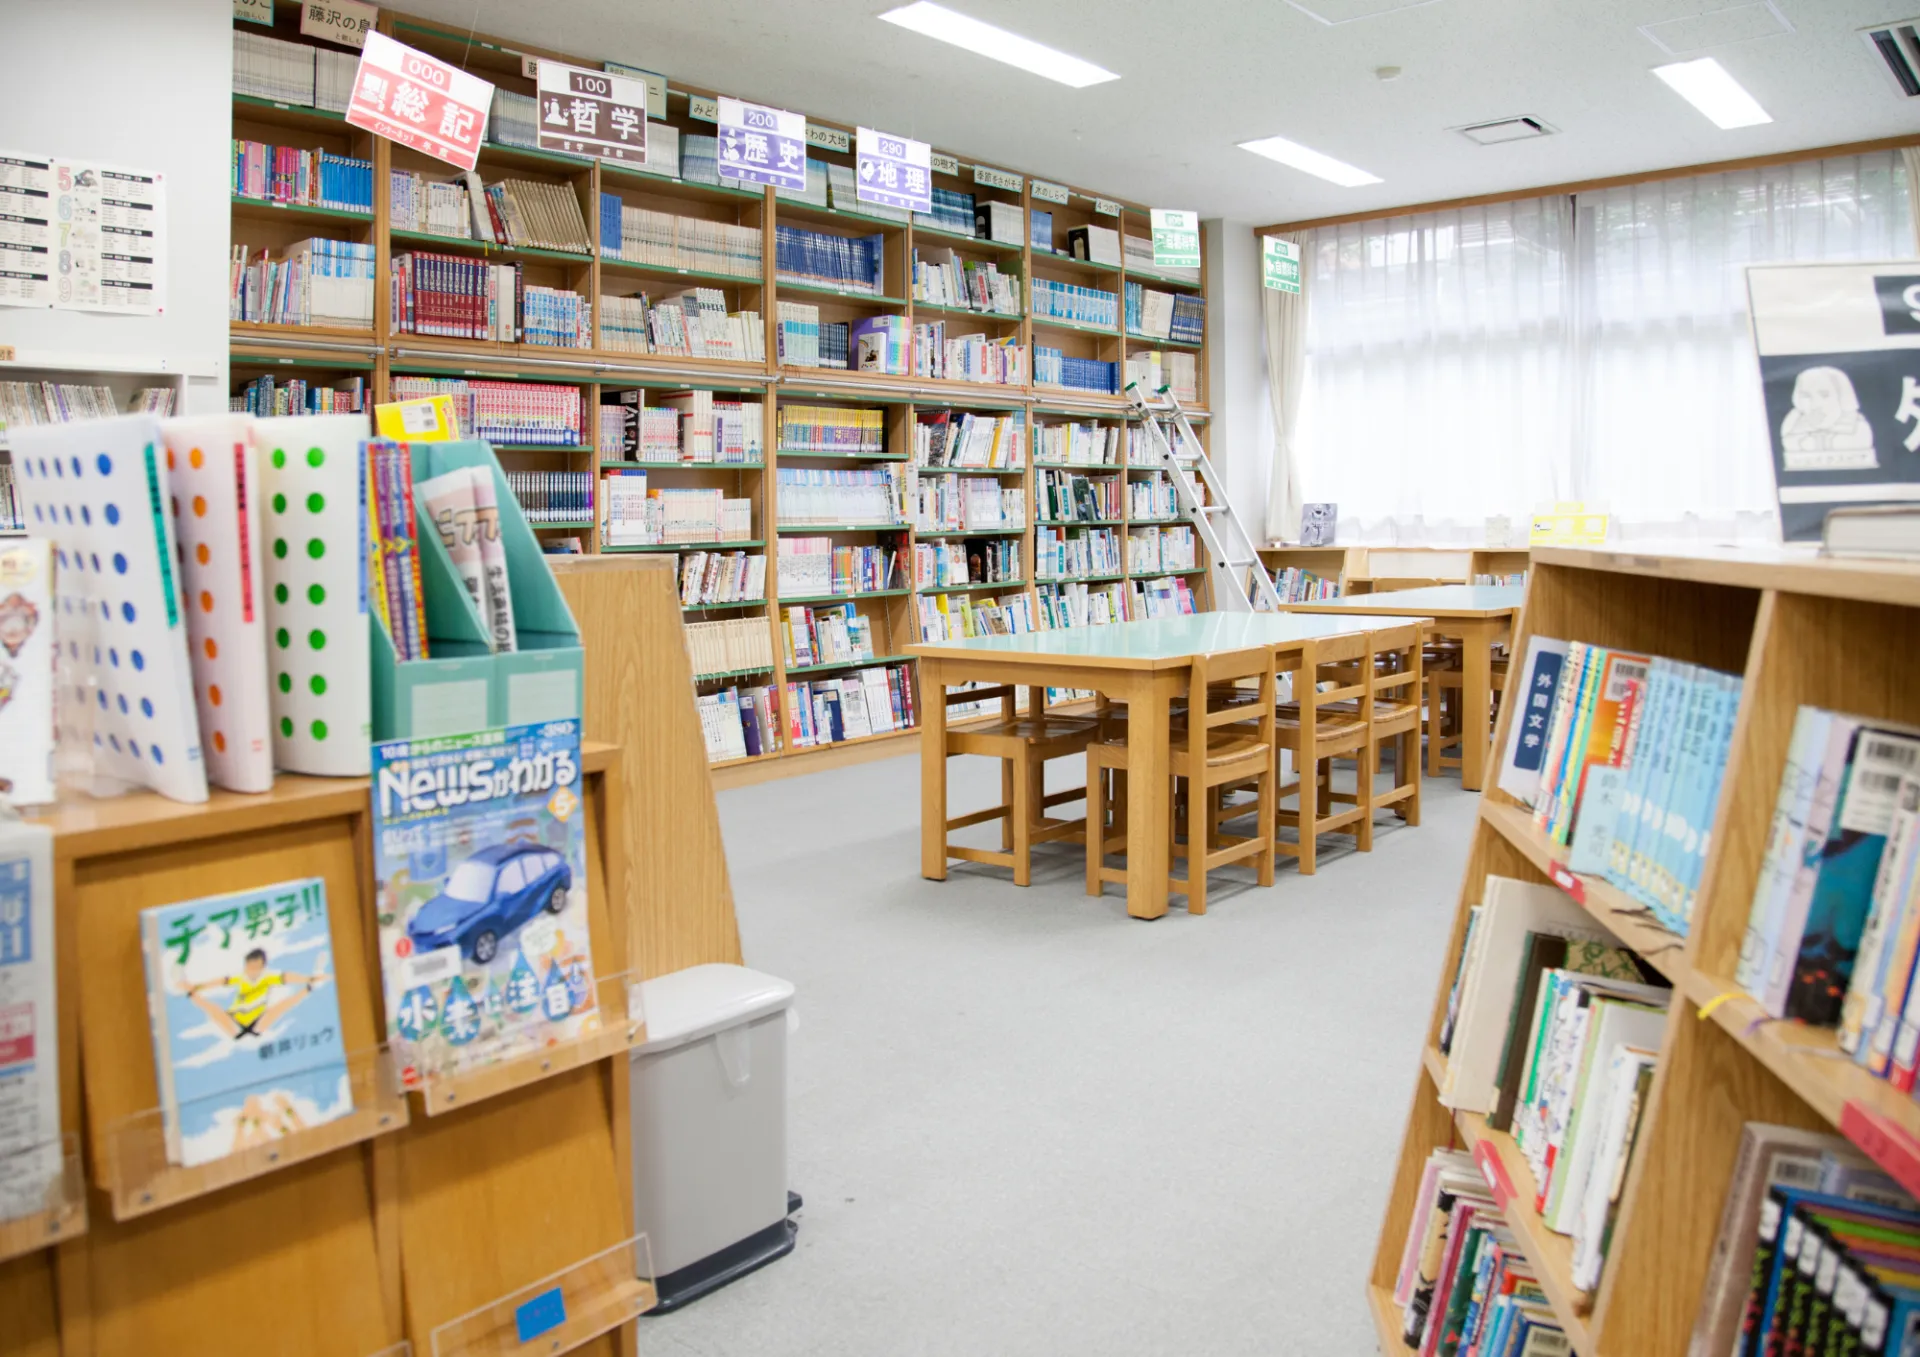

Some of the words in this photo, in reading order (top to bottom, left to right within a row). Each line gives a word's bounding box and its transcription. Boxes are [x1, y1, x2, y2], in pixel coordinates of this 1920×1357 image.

[408, 60, 445, 85] 000
[576, 76, 607, 95] 100
[390, 81, 475, 144] 総記
[570, 98, 640, 140] 哲学
[747, 112, 775, 127] 200
[374, 122, 415, 143] インターネット
[743, 133, 799, 171] 歴史
[882, 140, 903, 155] 290
[57, 166, 72, 192] 5
[877, 159, 925, 194] 地理
[58, 194, 72, 221] 6
[58, 222, 72, 248] 7
[58, 250, 72, 275] 8
[1523, 672, 1553, 749] 外国文学
[164, 883, 323, 965] チア男子!!
